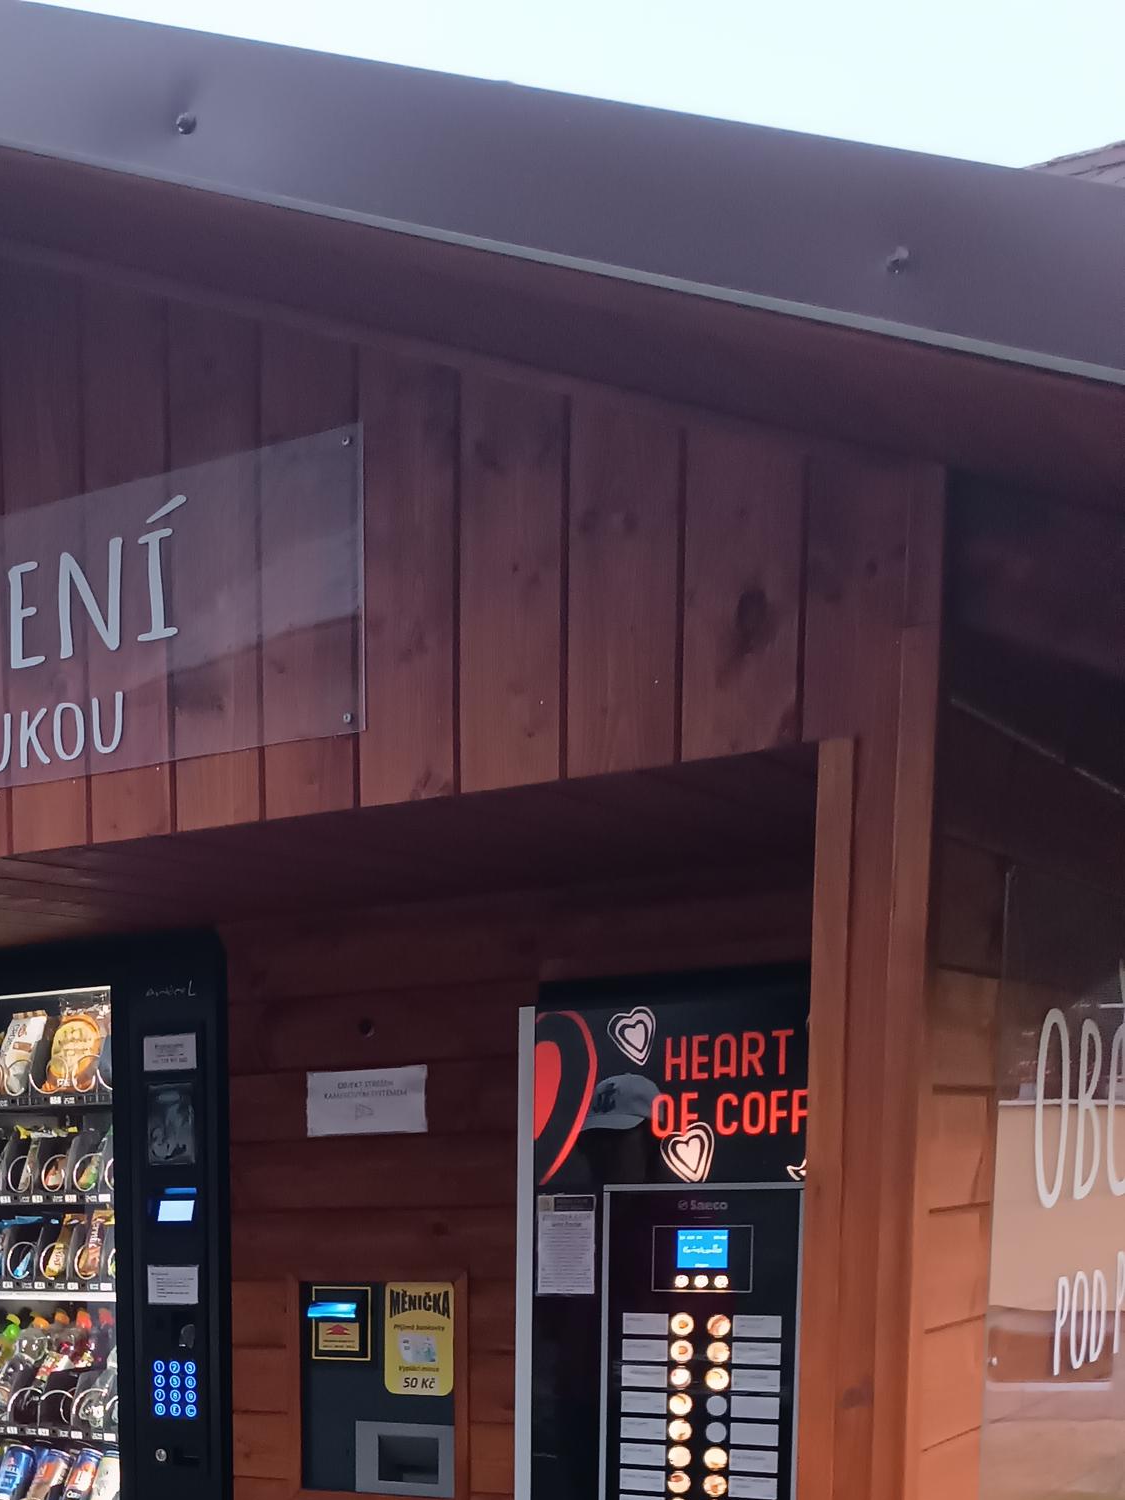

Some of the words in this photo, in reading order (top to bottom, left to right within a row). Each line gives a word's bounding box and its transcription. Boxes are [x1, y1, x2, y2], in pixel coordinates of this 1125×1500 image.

[663, 1028, 795, 1082] HEART
[650, 1091, 700, 1139] OF
[689, 1199, 729, 1211] Saeco
[389, 1288, 451, 1320] MĚNIČKA
[1053, 1268, 1108, 1376] POD
[402, 1377, 418, 1389] 50
[421, 1377, 436, 1390] Kč
